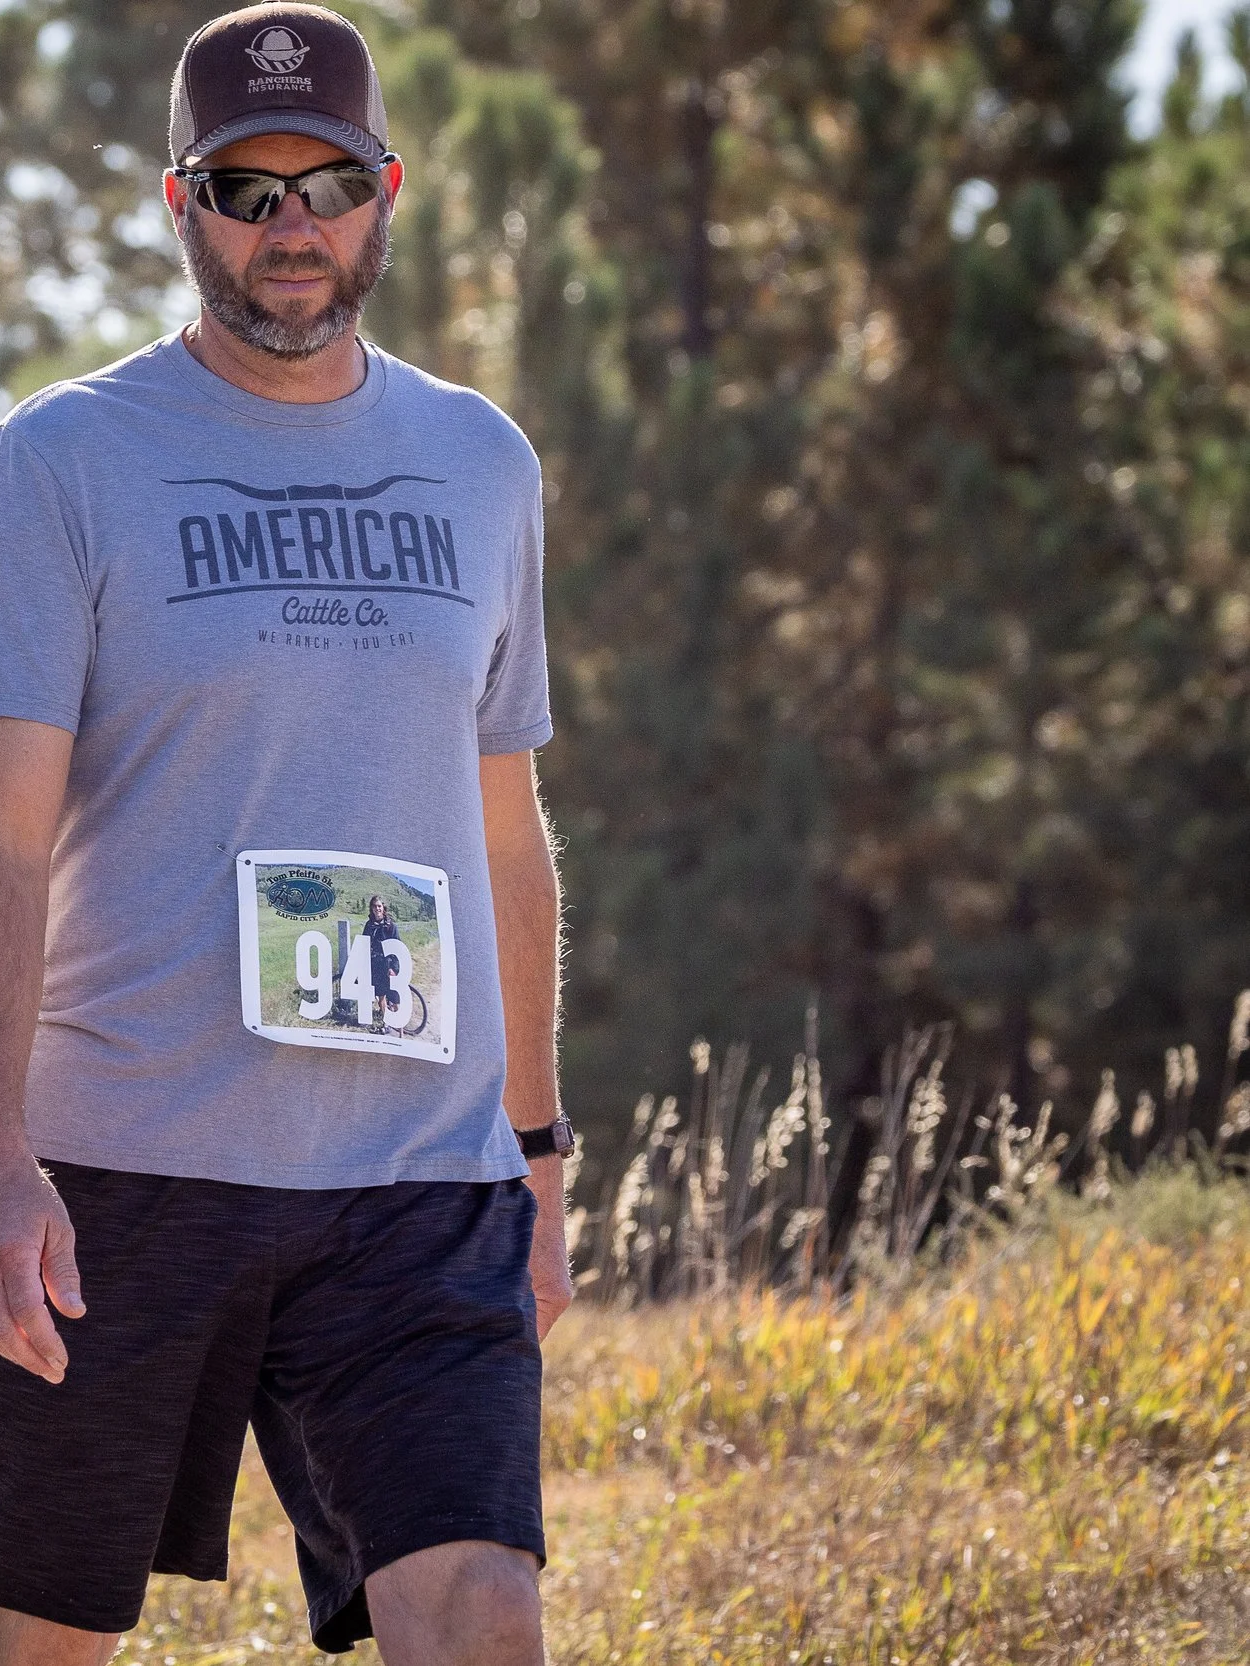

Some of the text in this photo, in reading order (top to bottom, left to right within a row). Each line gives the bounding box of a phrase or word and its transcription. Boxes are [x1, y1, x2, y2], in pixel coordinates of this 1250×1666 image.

[248, 76, 312, 87] RANCHERS
[248, 83, 313, 93] INSURANCE
[178, 507, 461, 591] AMERICAN
[282, 596, 389, 627] Cattle Co.
[258, 629, 415, 650] WE RANCH YOU EAT
[266, 873, 288, 885] Tom
[321, 876, 333, 887] 5k
[275, 911, 298, 921] RAPID
[295, 930, 413, 1028] 943
